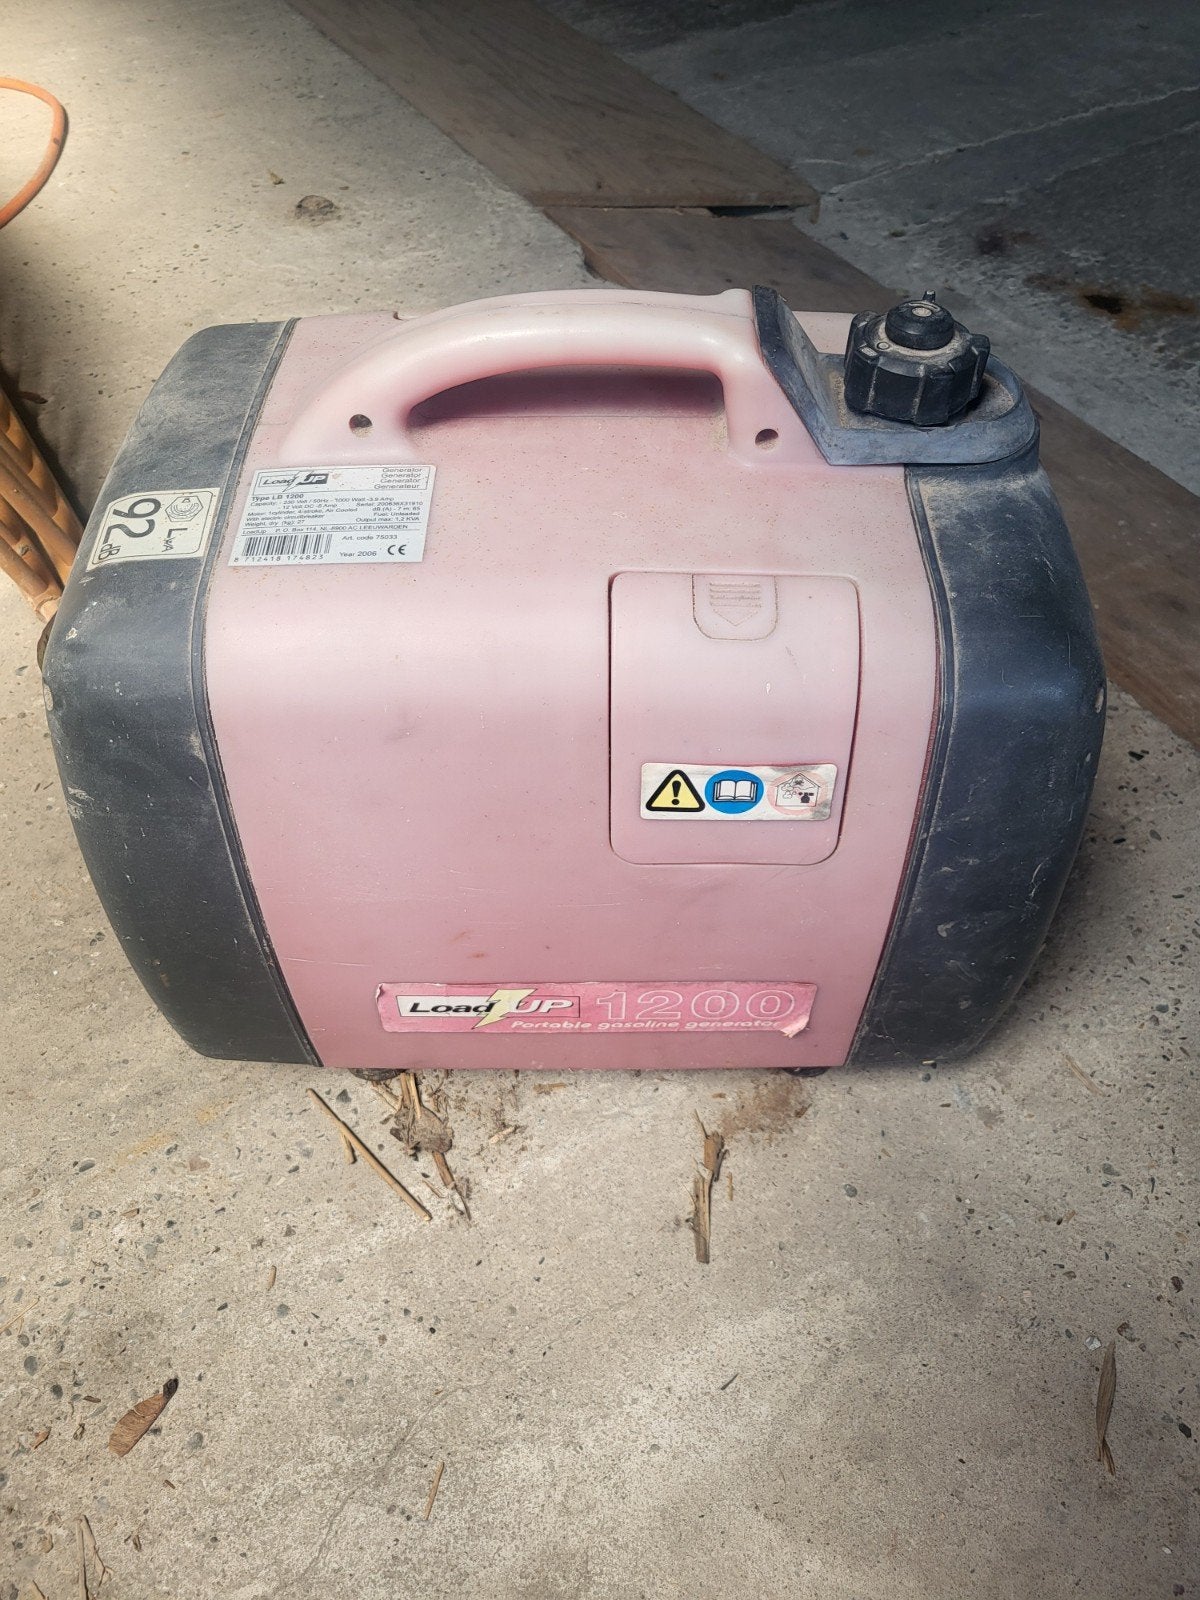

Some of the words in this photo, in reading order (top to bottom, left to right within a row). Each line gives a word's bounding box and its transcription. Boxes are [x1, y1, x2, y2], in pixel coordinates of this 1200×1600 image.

[263, 477, 296, 486] Load
[103, 498, 161, 545] 92
[98, 543, 121, 561] dB
[409, 1001, 496, 1014] Load
[511, 999, 575, 1014] UP
[596, 989, 797, 1021] 1200
[511, 1020, 593, 1031] Portable
[597, 1020, 680, 1031] gasoline
